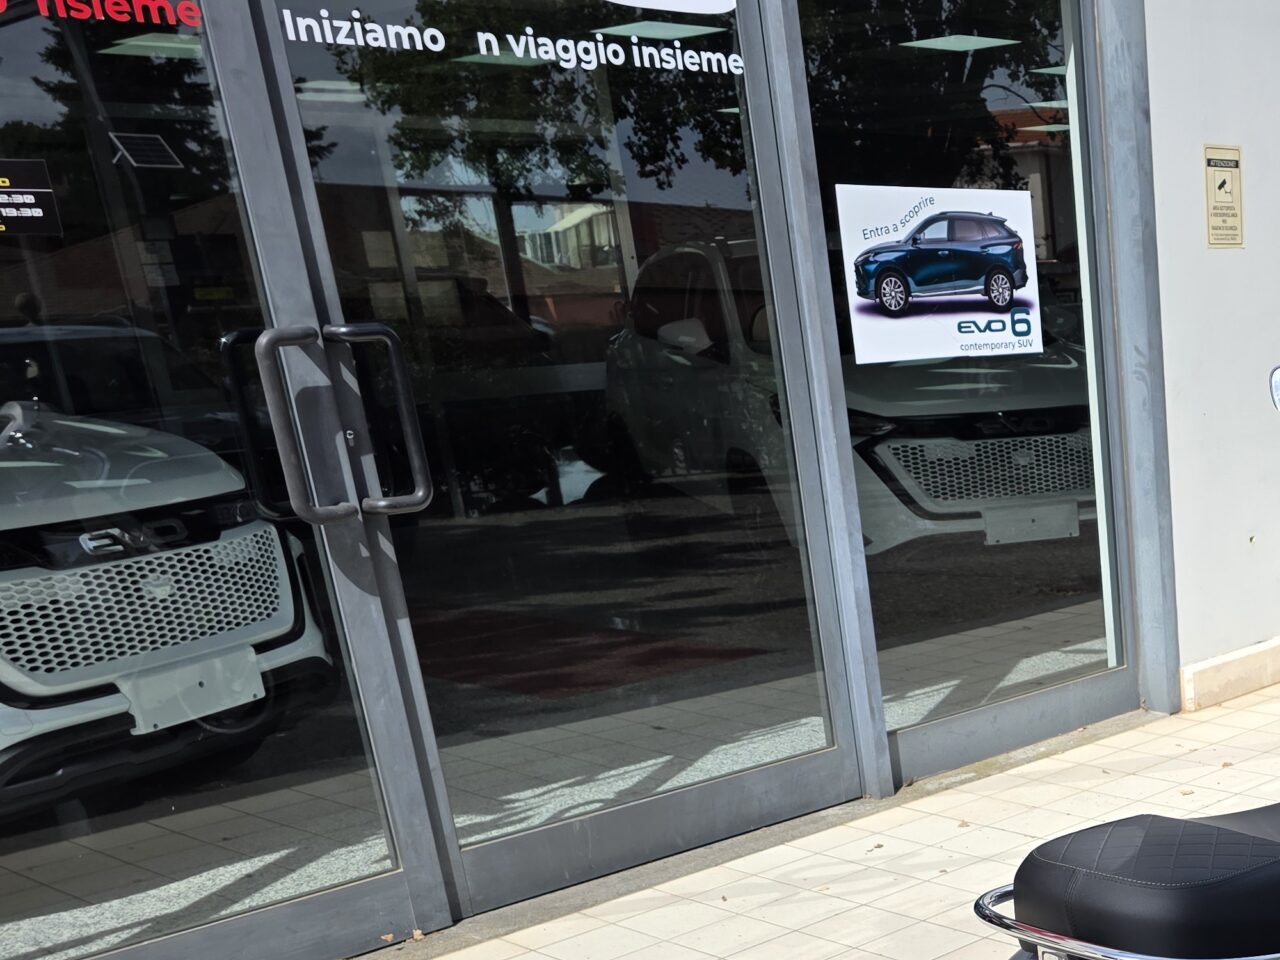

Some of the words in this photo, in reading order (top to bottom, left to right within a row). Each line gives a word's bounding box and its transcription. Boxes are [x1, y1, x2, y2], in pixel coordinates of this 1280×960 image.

[282, 8, 446, 52] Iniziamo
[505, 26, 626, 70] viaggio
[630, 34, 744, 75] insieme
[862, 225, 890, 241] Entra
[892, 223, 899, 233] a
[899, 196, 936, 228] scoprire
[957, 319, 1007, 333] EVO
[1010, 306, 1032, 338] 6
[960, 341, 1016, 352] contemporary
[1017, 338, 1034, 348] SUV
